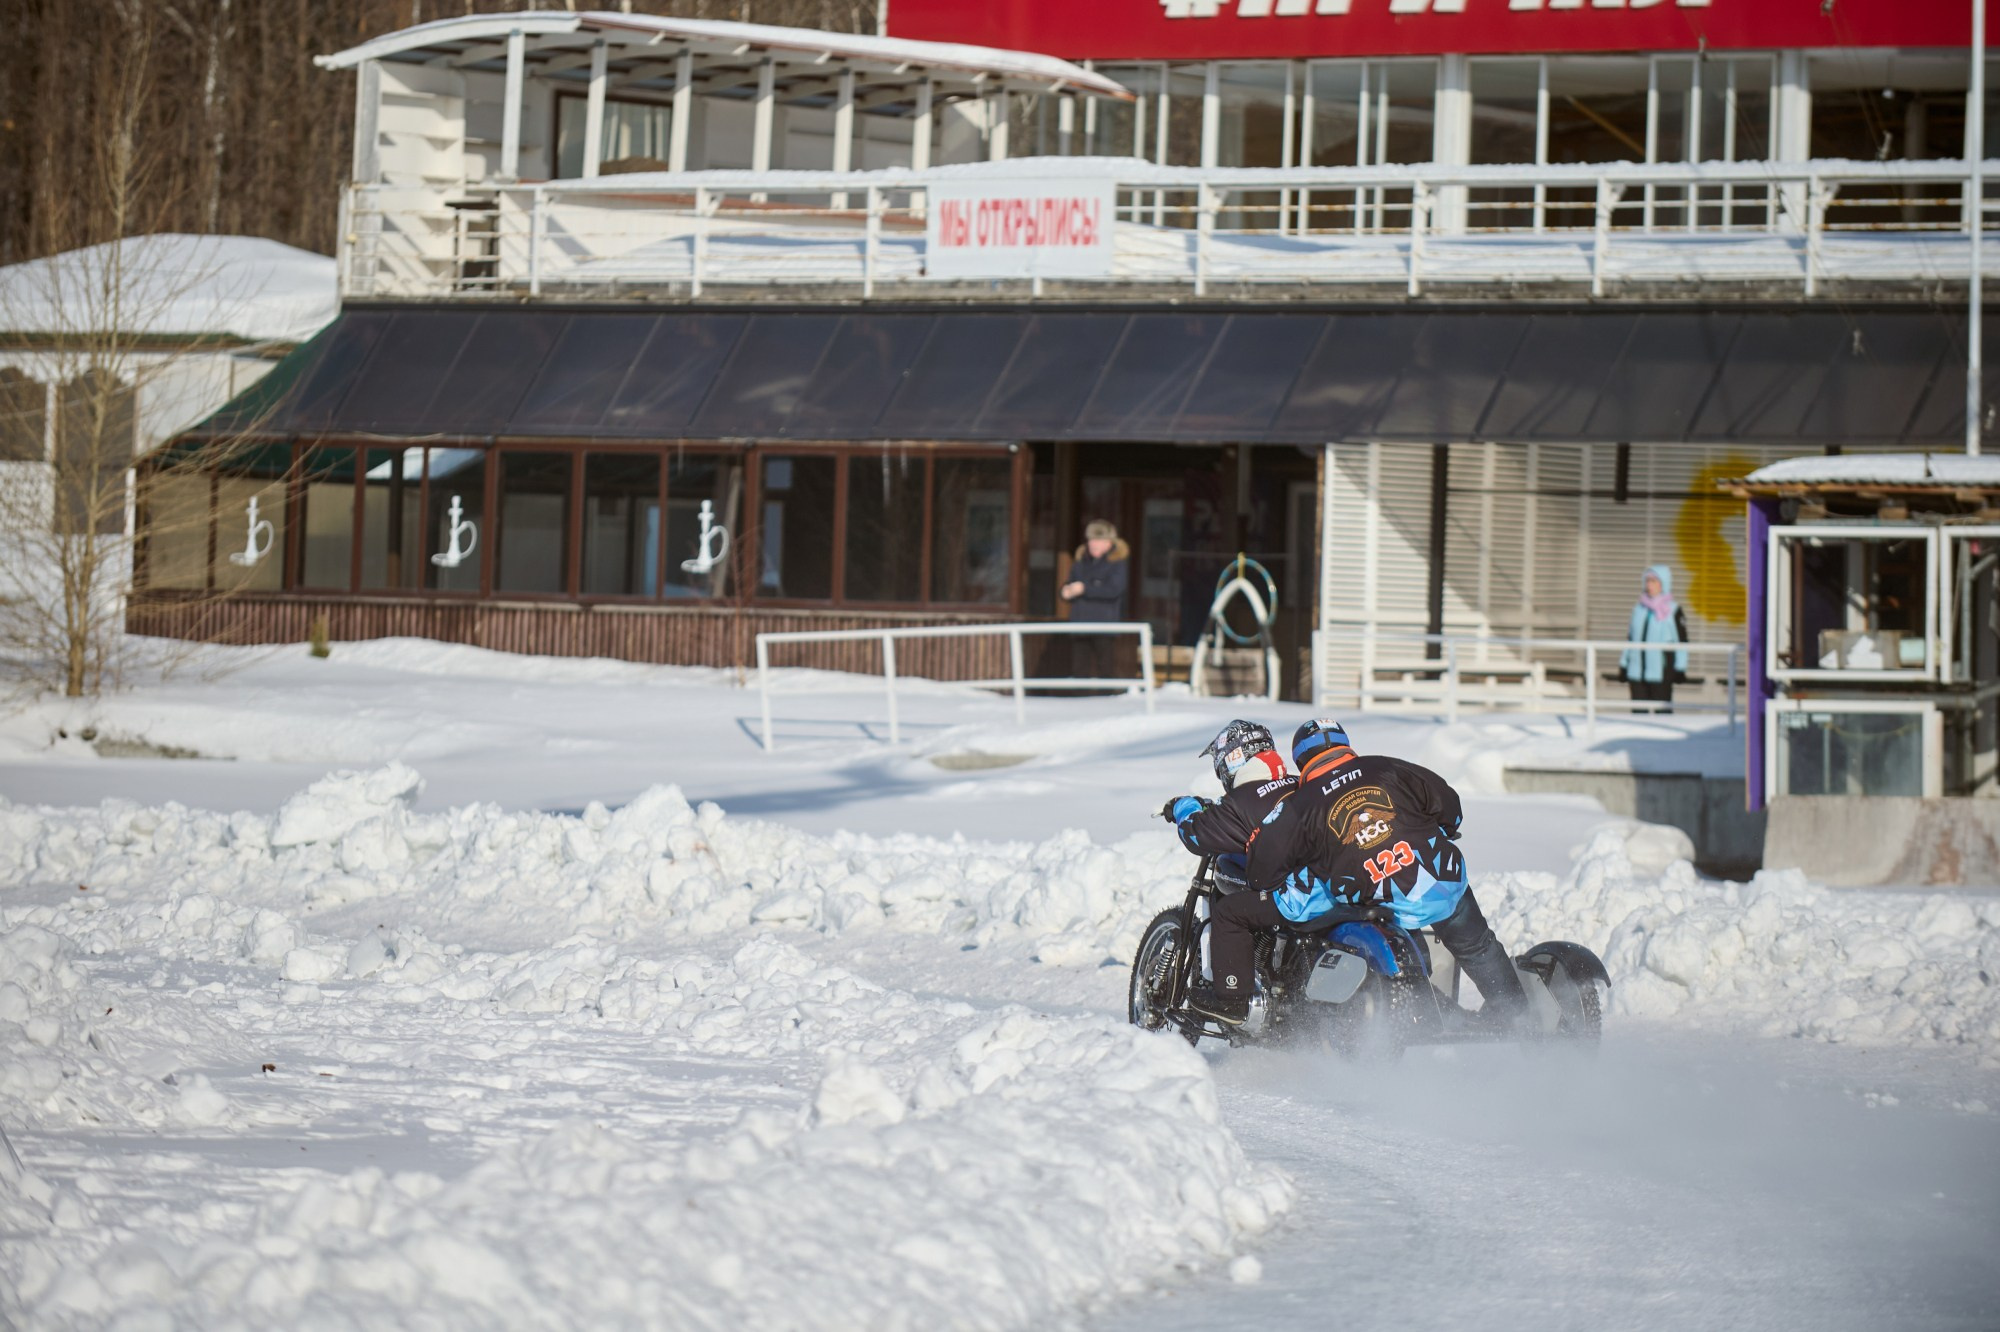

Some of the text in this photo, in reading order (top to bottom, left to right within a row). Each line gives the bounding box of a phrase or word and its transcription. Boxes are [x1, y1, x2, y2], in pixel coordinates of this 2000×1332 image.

[939, 197, 1099, 246] МЫ ОТКРЫЛИСЬ!
[1226, 748, 1242, 763] 123
[1321, 768, 1363, 796] LETIN
[1331, 789, 1381, 821] KRASNODAR CHAPTER
[1345, 796, 1367, 811] RUSSIA
[1354, 819, 1389, 846] HOG
[1363, 840, 1416, 884] 123
